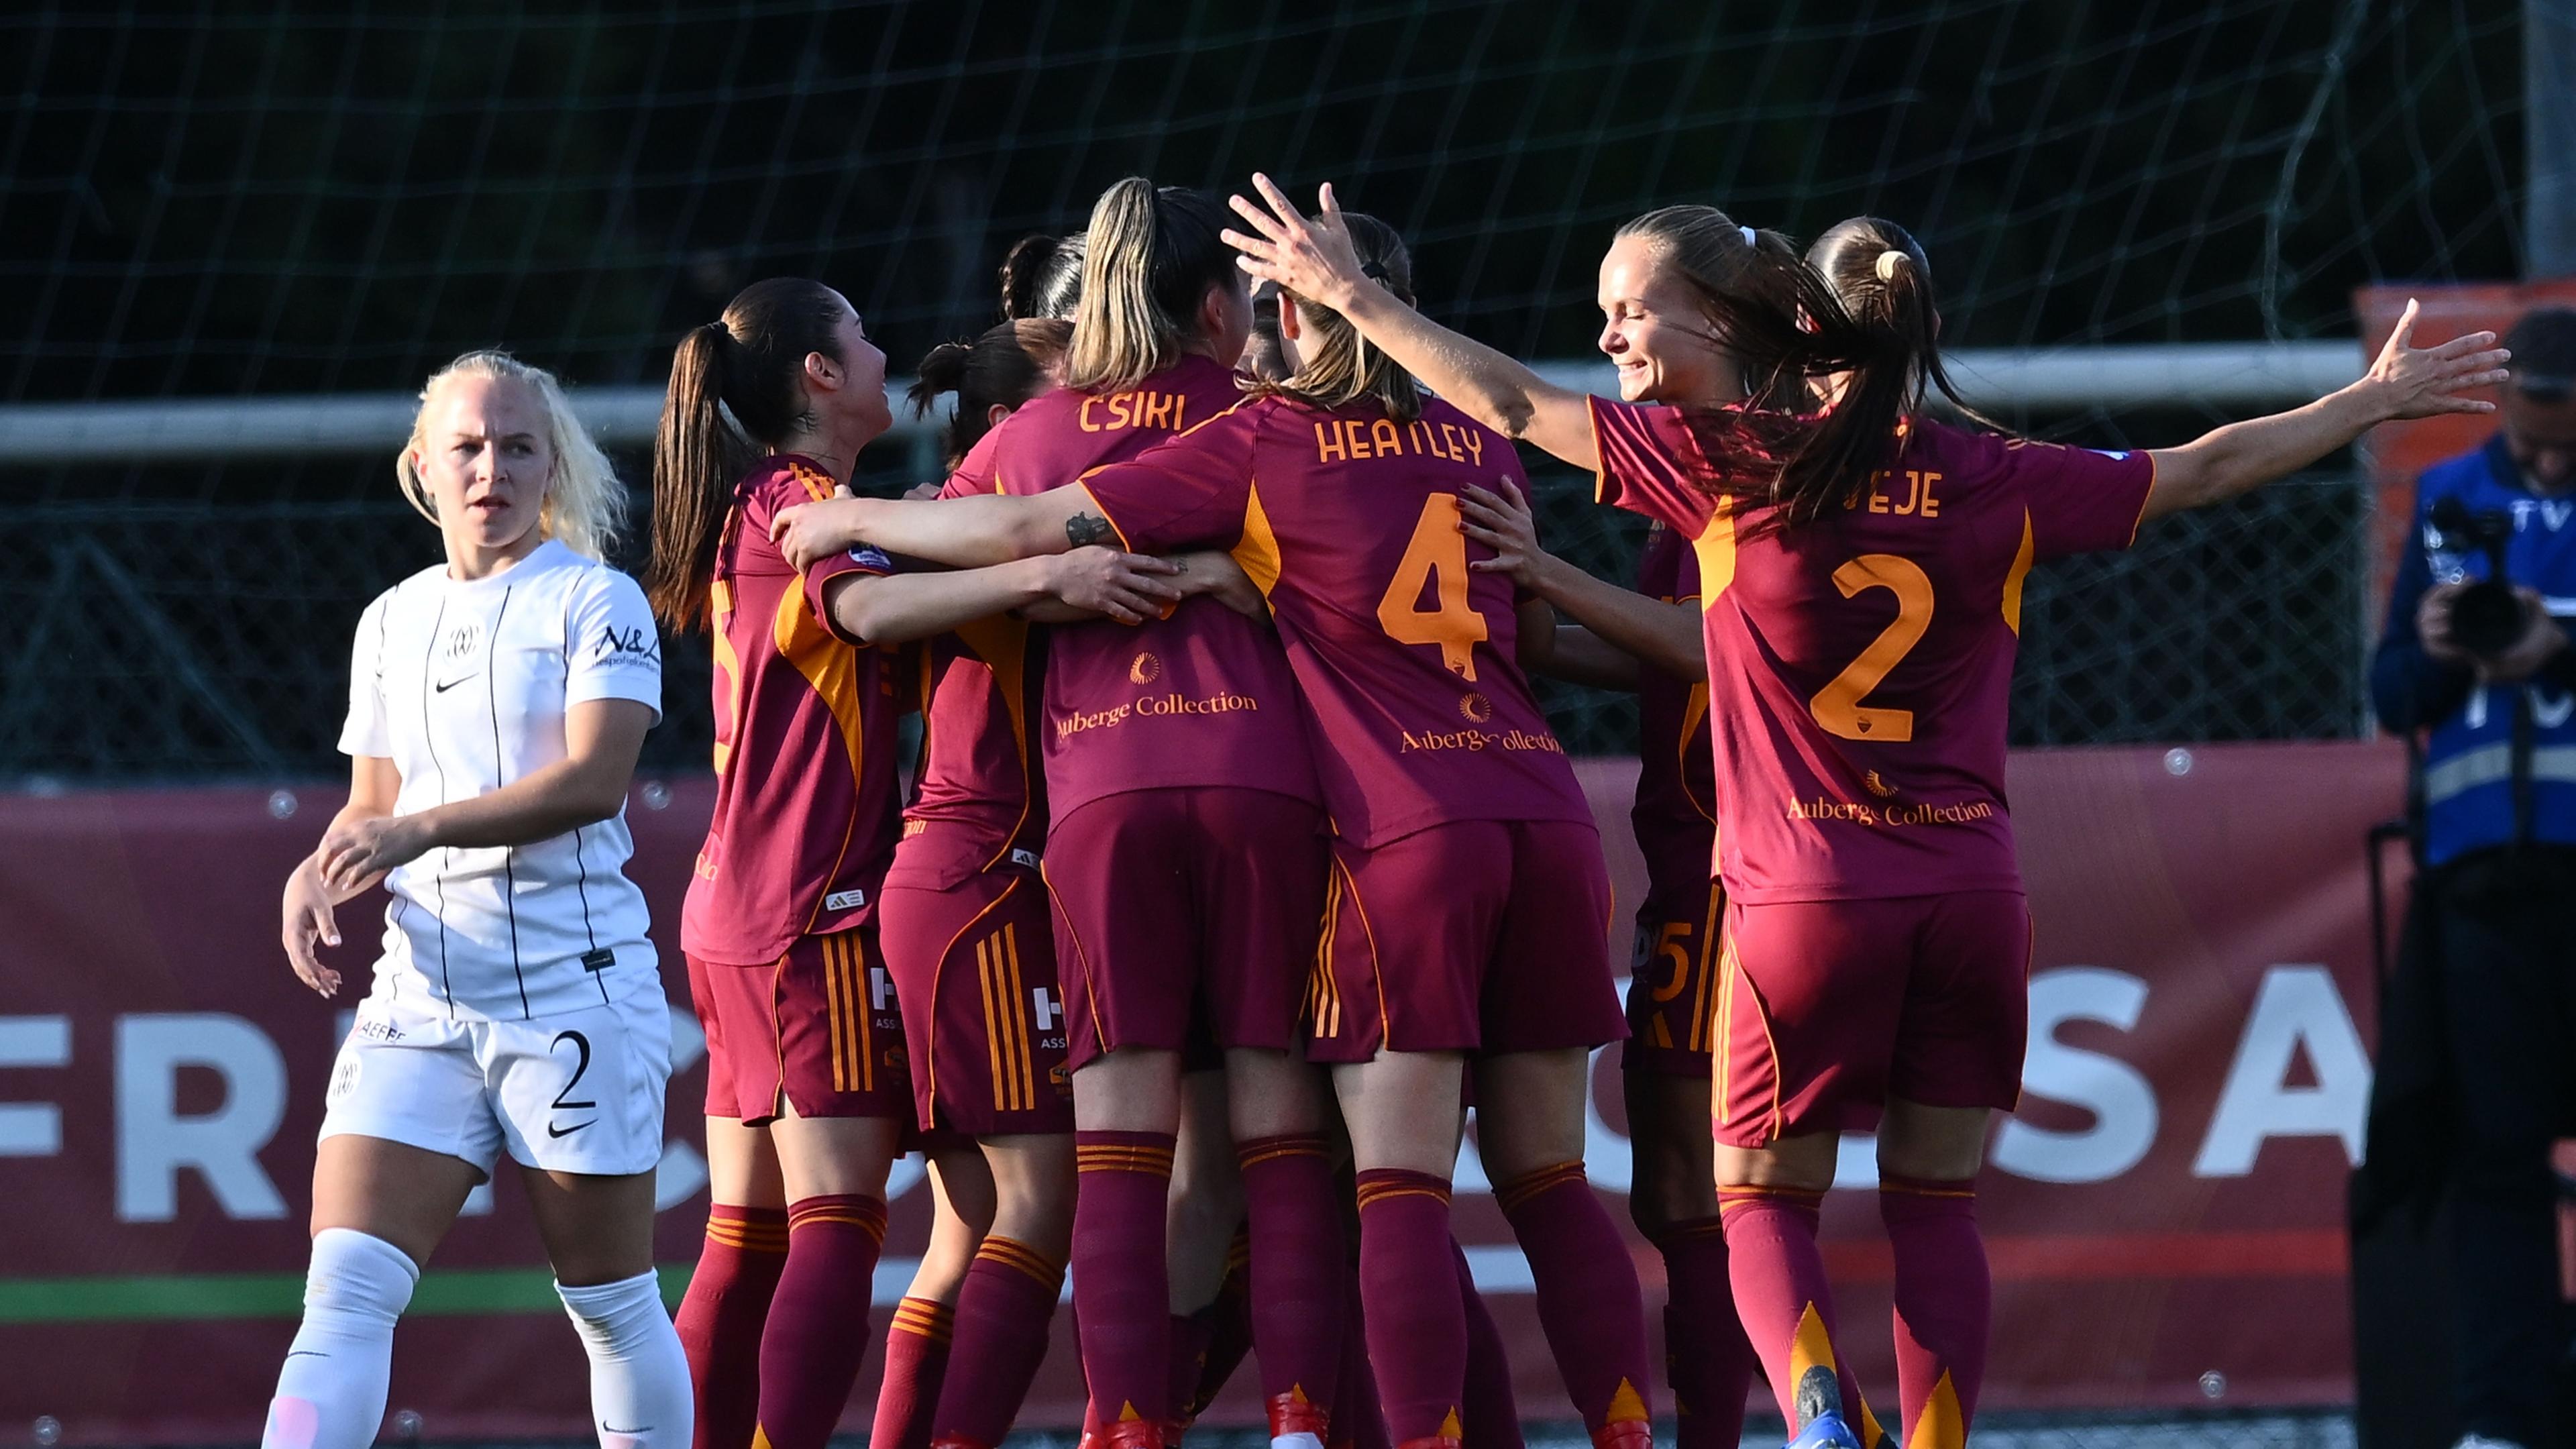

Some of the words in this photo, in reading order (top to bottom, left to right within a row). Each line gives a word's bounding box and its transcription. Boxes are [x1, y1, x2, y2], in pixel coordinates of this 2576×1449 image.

[1080, 391, 1185, 433] CSIKI
[1314, 419, 1482, 467] HEATLEY
[1843, 470, 1942, 518] EJE
[2508, 499, 2573, 533] TV
[1377, 492, 1488, 682] 4
[1810, 553, 1934, 742] 2
[1057, 703, 1130, 744] Auberge
[1136, 691, 1258, 716] Collection
[1885, 801, 1992, 826] Collection
[1652, 922, 1692, 1002] 5
[549, 1030, 596, 1109] 2
